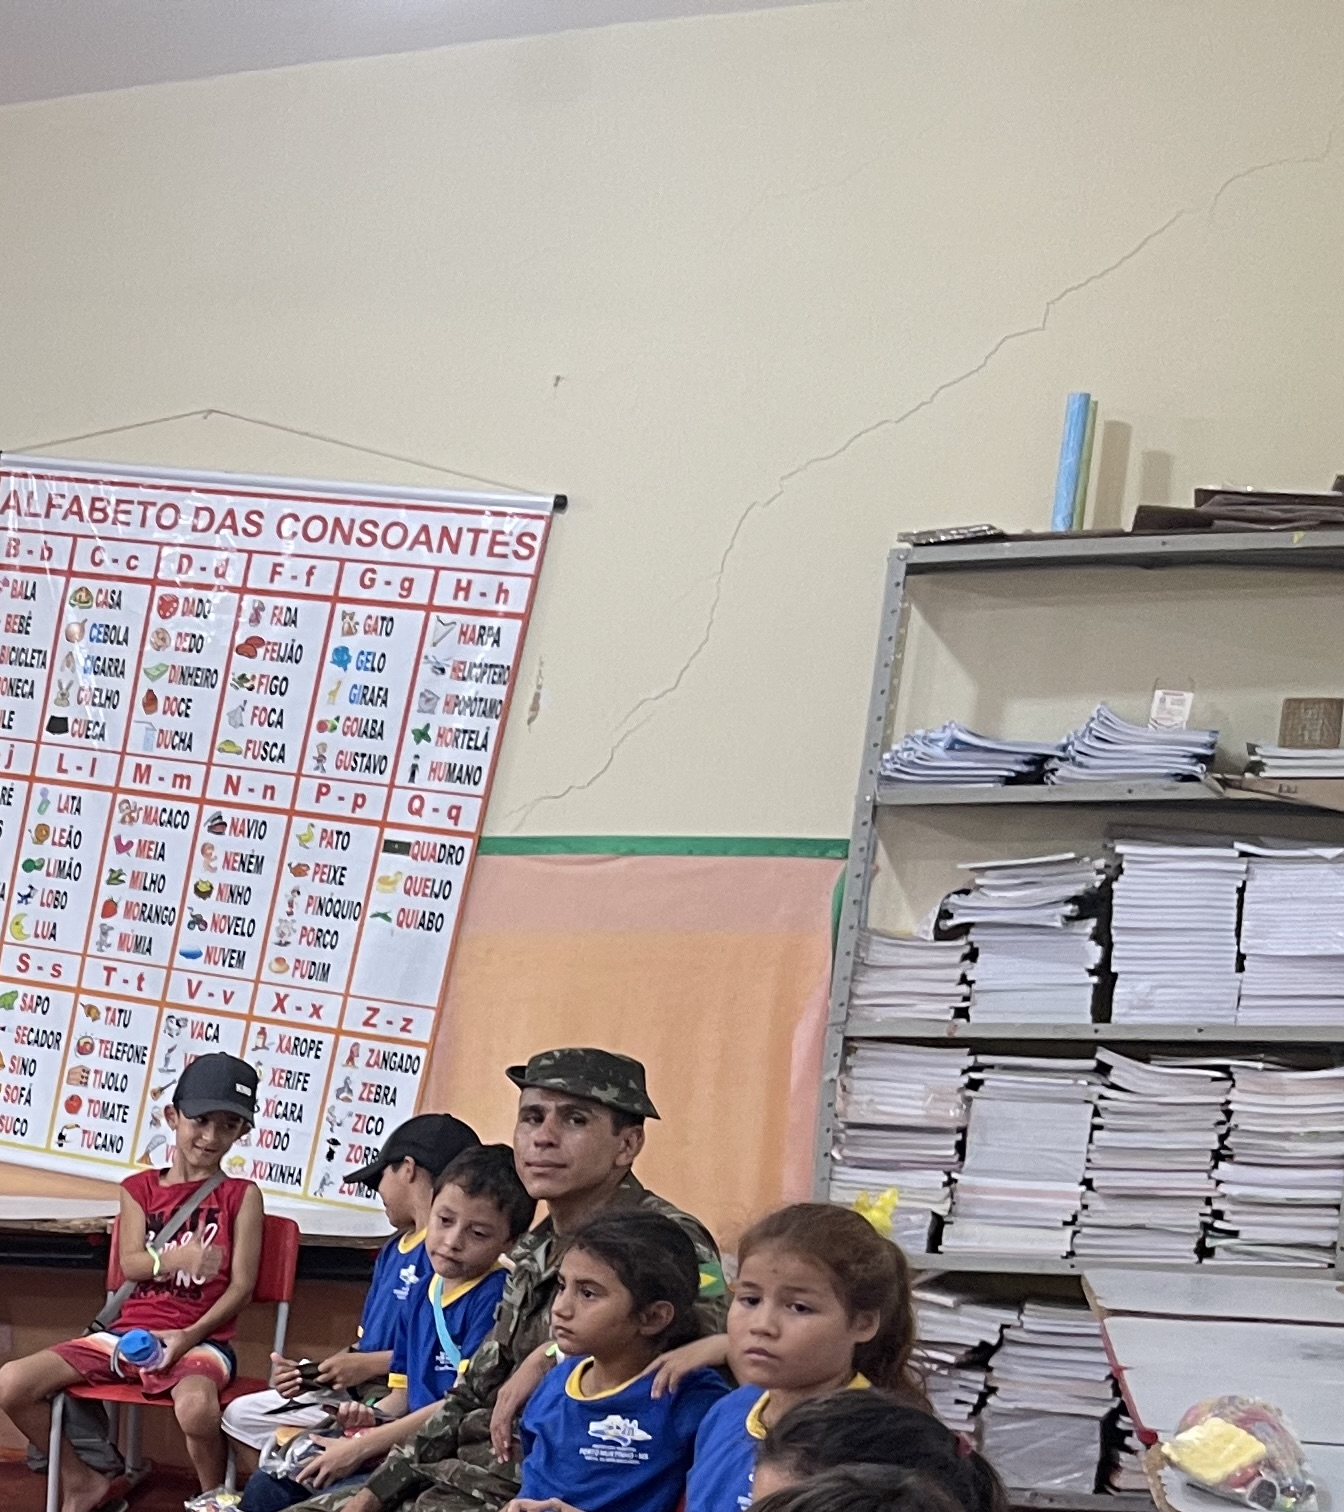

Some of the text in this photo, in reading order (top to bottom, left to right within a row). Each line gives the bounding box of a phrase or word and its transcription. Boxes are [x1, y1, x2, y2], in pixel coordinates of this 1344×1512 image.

[191, 506, 264, 538] DAS
[276, 512, 538, 560] CONSOANTES
[5, 538, 20, 558] B
[41, 540, 53, 560] b
[91, 546, 106, 567] C
[126, 554, 139, 570] c
[177, 554, 193, 574] D
[214, 558, 229, 579] d
[269, 562, 284, 584] F
[305, 565, 317, 586] f
[11, 579, 36, 601] BALA
[359, 568, 377, 590] G
[399, 576, 414, 599] g
[453, 578, 472, 601] H
[496, 582, 510, 604] h
[96, 588, 122, 610] CASA
[270, 605, 298, 628] FADA
[364, 615, 394, 637] GATO
[89, 623, 129, 647] CEBOLA
[175, 632, 204, 654] DEDO
[458, 623, 501, 648] HARPA
[0, 645, 47, 669] BICICLETA
[263, 639, 303, 664] FEIJÃO
[355, 650, 386, 673] GELO
[83, 655, 125, 679] CIGARRA
[168, 664, 218, 689] DINHEIRO
[256, 674, 289, 696] FIGO
[349, 684, 389, 707] GIRAFA
[77, 686, 120, 709] COELHO
[162, 696, 193, 718] DOCE
[250, 705, 284, 729] FOCA
[342, 716, 384, 740] GOIABA
[71, 719, 106, 741] CUECA
[156, 729, 193, 752] DUCHA
[4, 744, 14, 769] j
[244, 739, 286, 763] FUSCA
[335, 750, 388, 775] GUSTAVO
[57, 753, 68, 774] L
[89, 758, 97, 777] l
[132, 763, 152, 784] M
[172, 773, 191, 790] m
[428, 761, 483, 786] HUMANO
[224, 774, 241, 796] N
[262, 783, 275, 800] n
[315, 783, 331, 804] P
[352, 793, 367, 813] p
[57, 794, 82, 815] LATA
[408, 794, 425, 818] Q
[447, 804, 462, 826] q
[141, 805, 190, 830] MACACO
[229, 817, 267, 840] NAVIO
[51, 825, 82, 850] LEÃO
[319, 828, 351, 851] PATO
[135, 839, 166, 861] MEIA
[411, 840, 465, 866] QUADRO
[45, 857, 82, 881] LIMÃO
[312, 862, 347, 886] PEIXE
[129, 870, 166, 894] MILHO
[403, 876, 452, 900] QUEIJO
[39, 888, 68, 909] LOBO
[215, 883, 252, 906] NINHO
[305, 892, 362, 921] PINÓQUIO
[122, 901, 176, 926] MORANGO
[210, 913, 256, 938] NOVELO
[396, 907, 445, 933] QUIABO
[34, 920, 57, 941] LUA
[117, 929, 153, 956] MÚMIA
[299, 926, 339, 950] PORCO
[17, 952, 31, 973] S
[50, 963, 62, 978] s
[203, 945, 246, 970] NUVEM
[103, 965, 117, 986] T
[136, 972, 145, 992] t
[291, 958, 331, 983] PUDIM
[187, 978, 202, 1000] V
[222, 989, 235, 1005] v
[19, 993, 50, 1016] SAPO
[272, 992, 289, 1014] X
[309, 1003, 324, 1020] x
[104, 1006, 132, 1029] TATU
[362, 1006, 380, 1028] Z
[400, 1017, 413, 1033] z
[14, 1025, 62, 1051] SECADOR
[190, 1020, 220, 1044] VACA
[97, 1039, 148, 1065] TELEFONE
[275, 1033, 324, 1060] XAROPE
[9, 1055, 37, 1077] SINO
[365, 1048, 420, 1075] ZANGADO
[93, 1069, 129, 1094] TIJOLO
[268, 1067, 311, 1092] XERIFE
[2, 1082, 32, 1107] SOFÁ
[358, 1082, 397, 1106] ZEBRA
[87, 1099, 129, 1123] TOMATE
[262, 1095, 304, 1123] XÍCARA
[352, 1113, 385, 1136] ZICO
[80, 1128, 124, 1154] TUCANO
[256, 1127, 290, 1151] XODÓ
[345, 1143, 379, 1166] ZORR
[250, 1159, 302, 1187] XUXINHA
